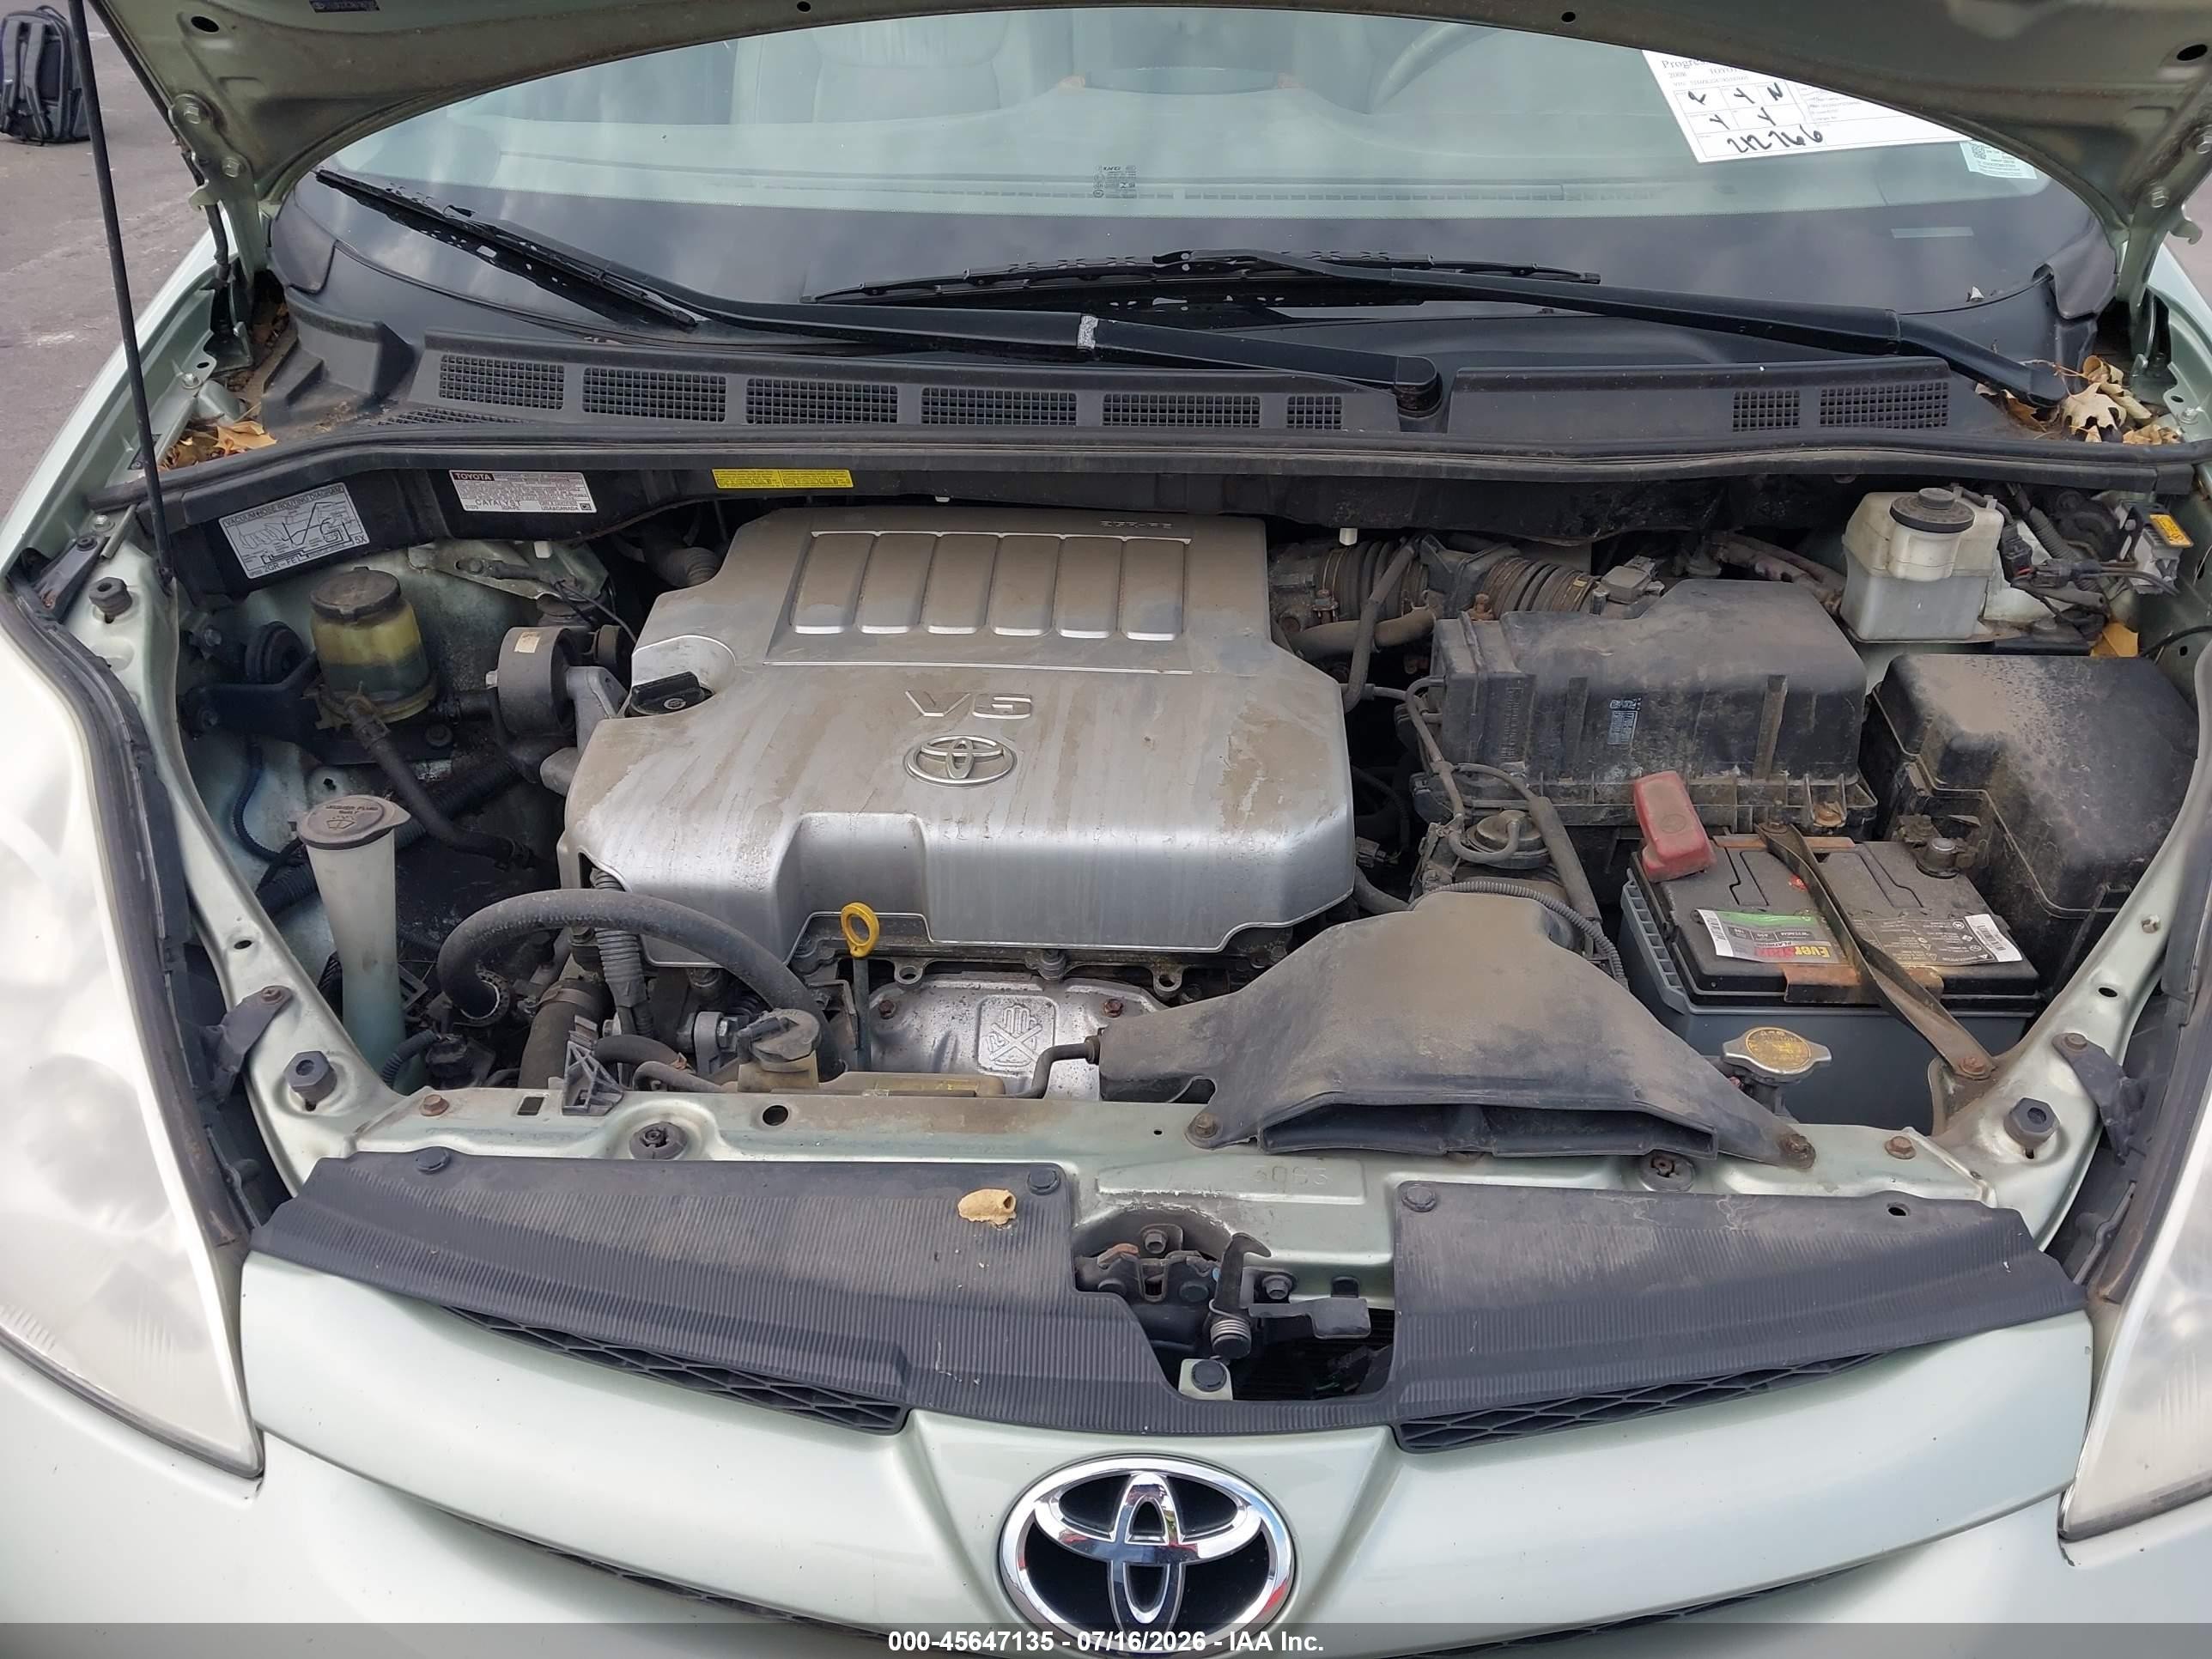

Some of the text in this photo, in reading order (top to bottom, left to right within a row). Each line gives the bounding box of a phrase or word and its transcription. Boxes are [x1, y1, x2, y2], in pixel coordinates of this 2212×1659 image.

[455, 472, 493, 481] TOYOTA
[225, 513, 258, 526] VACUUM
[355, 535, 368, 544] 5X
[905, 690, 1031, 719] V6
